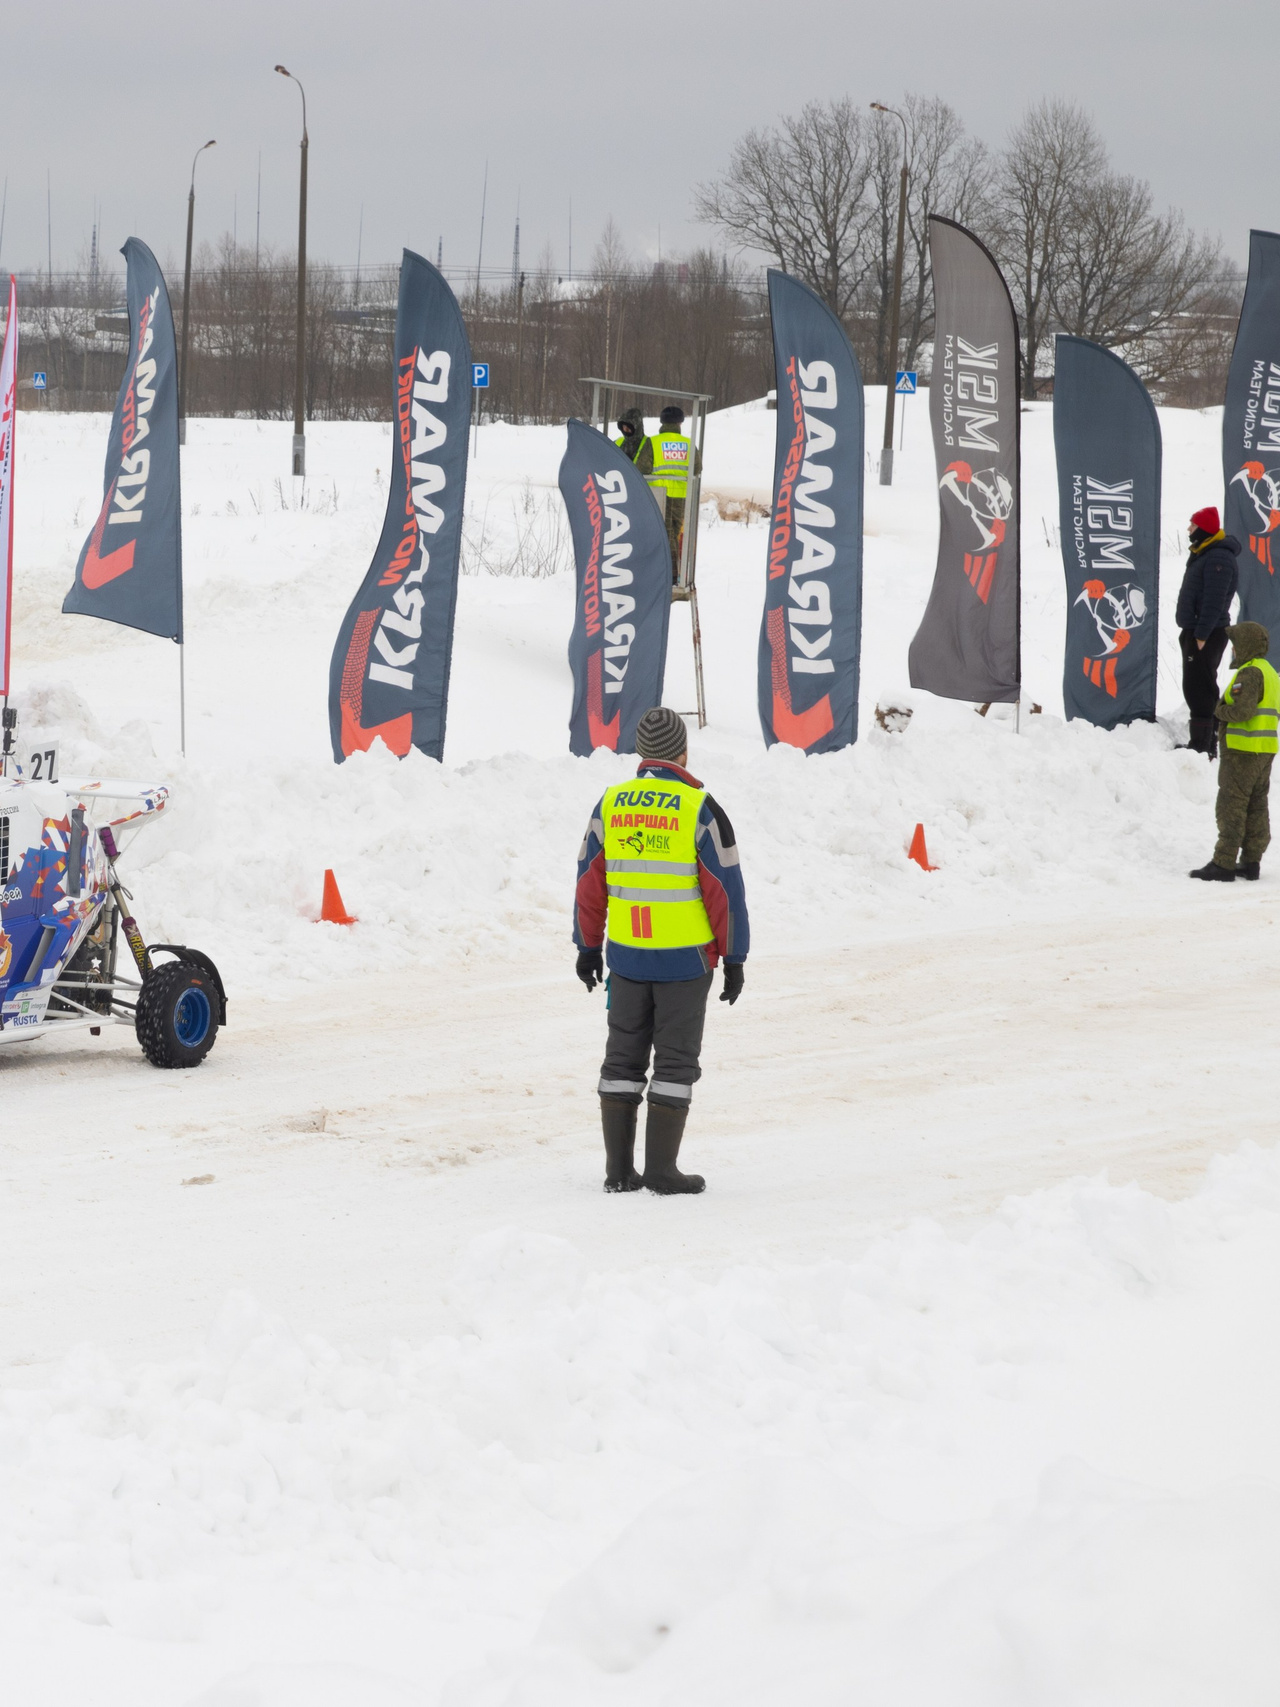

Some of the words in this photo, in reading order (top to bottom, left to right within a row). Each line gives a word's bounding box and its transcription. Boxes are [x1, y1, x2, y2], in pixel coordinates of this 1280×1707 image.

[474, 366, 486, 384] P
[663, 443, 687, 451] LIQUI
[664, 451, 687, 460] MOLY
[31, 750, 55, 780] 27
[613, 790, 681, 810] RUSTA
[610, 813, 679, 831] МАРШАЛ
[646, 834, 670, 850] MSK
[13, 1014, 38, 1026] RUSTA
